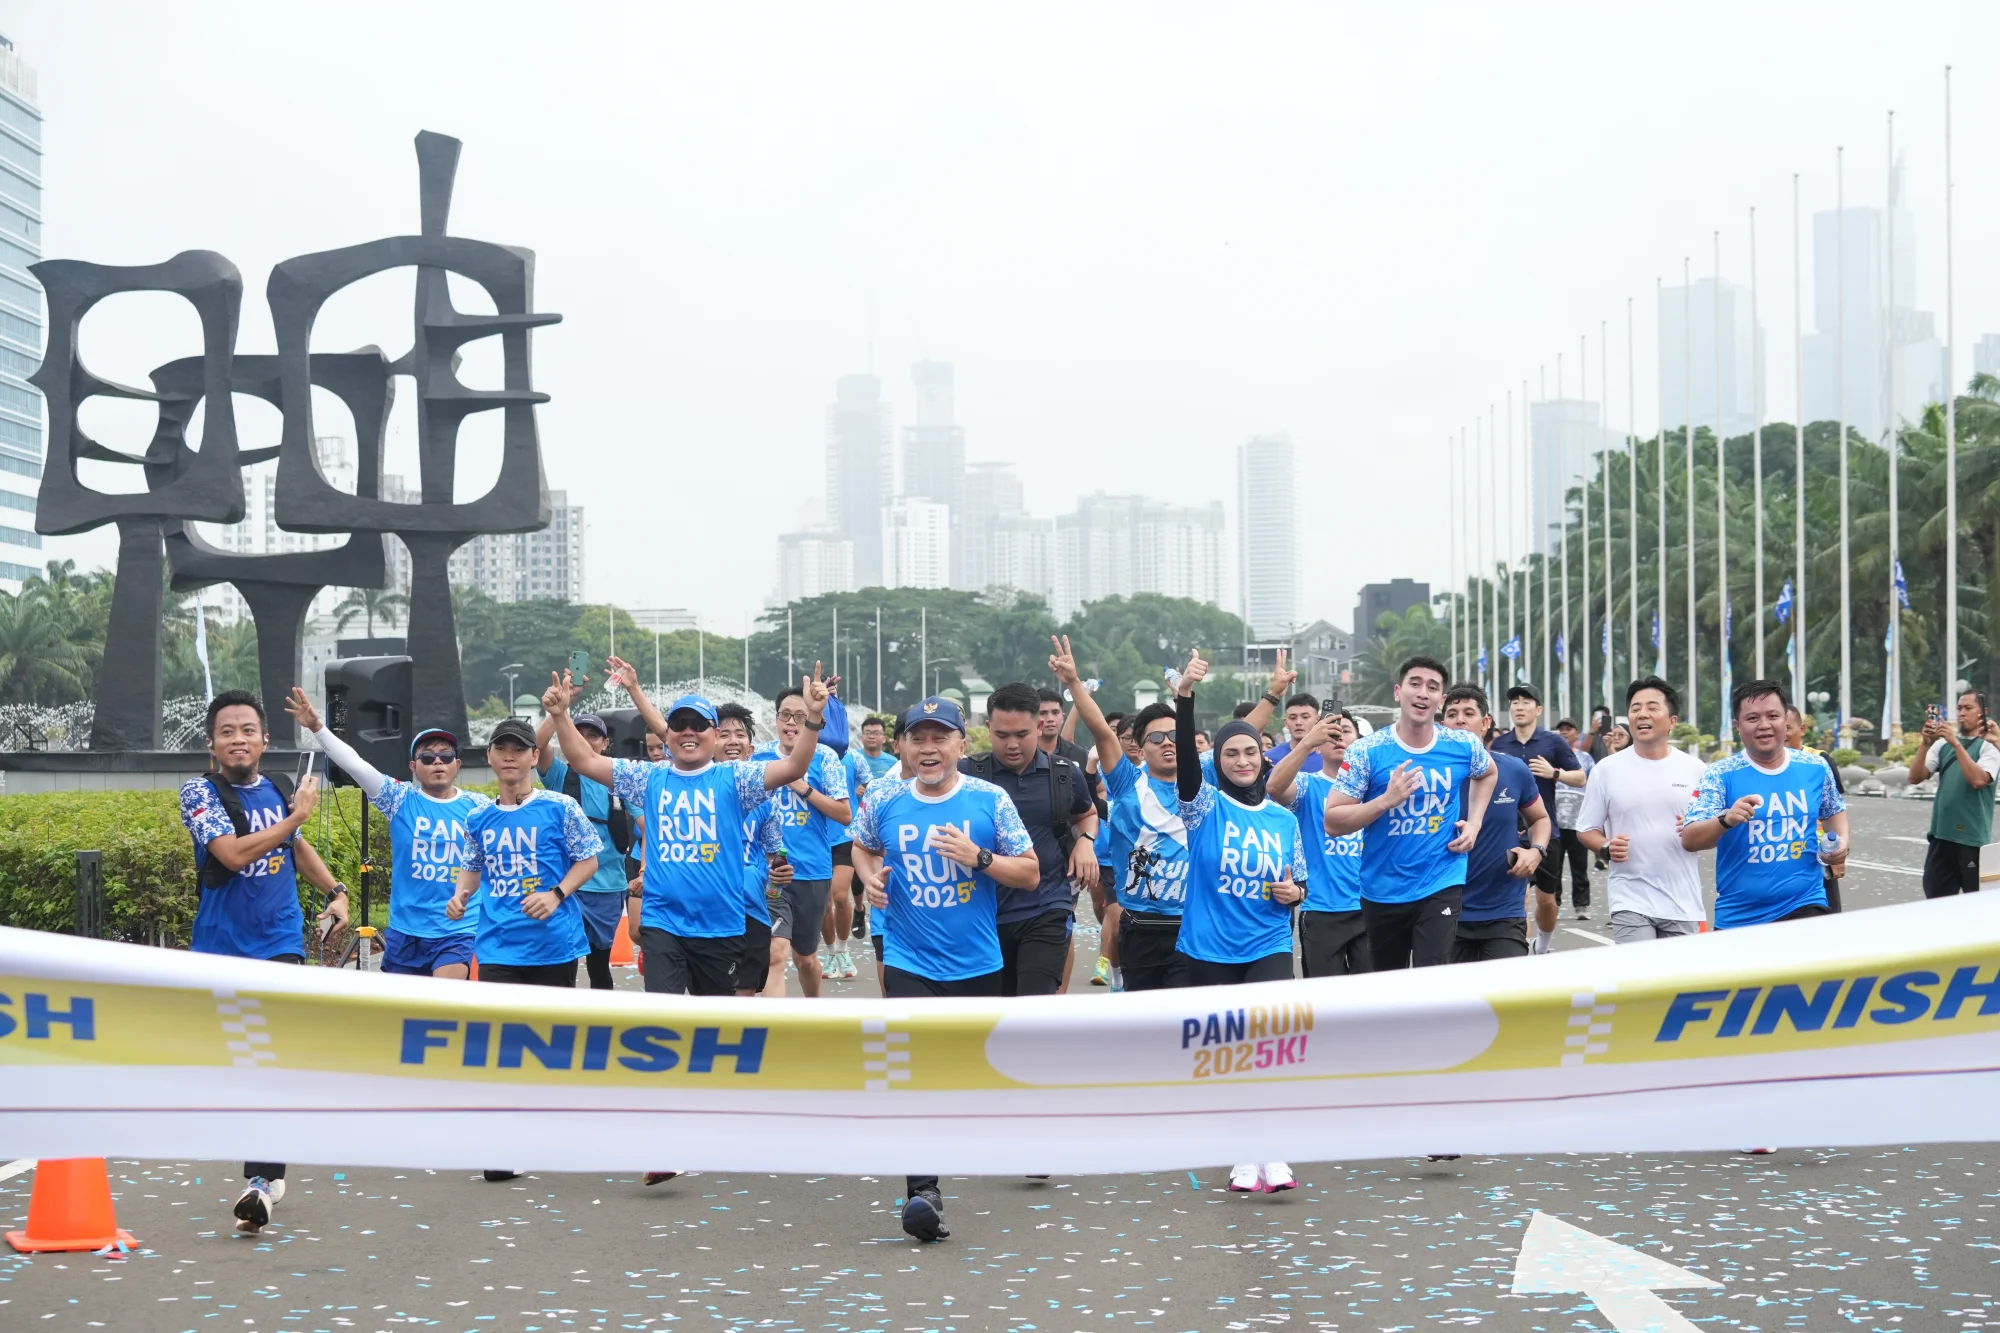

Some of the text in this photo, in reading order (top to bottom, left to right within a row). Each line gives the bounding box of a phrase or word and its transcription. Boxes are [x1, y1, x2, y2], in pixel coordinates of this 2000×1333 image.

[658, 788, 716, 815] PAN
[777, 791, 808, 811] UN
[244, 805, 284, 833] AN
[658, 814, 717, 842] RUN
[1749, 815, 1809, 845] RUN
[482, 826, 538, 853] PAN
[1223, 820, 1283, 857] PAN
[484, 853, 539, 878] RUN
[901, 853, 973, 884] RUN
[1220, 847, 1283, 883] RUN
[1653, 965, 2000, 1043] FINISH
[400, 1018, 769, 1075] FINISH
[1193, 1035, 1309, 1079] 2025K!
